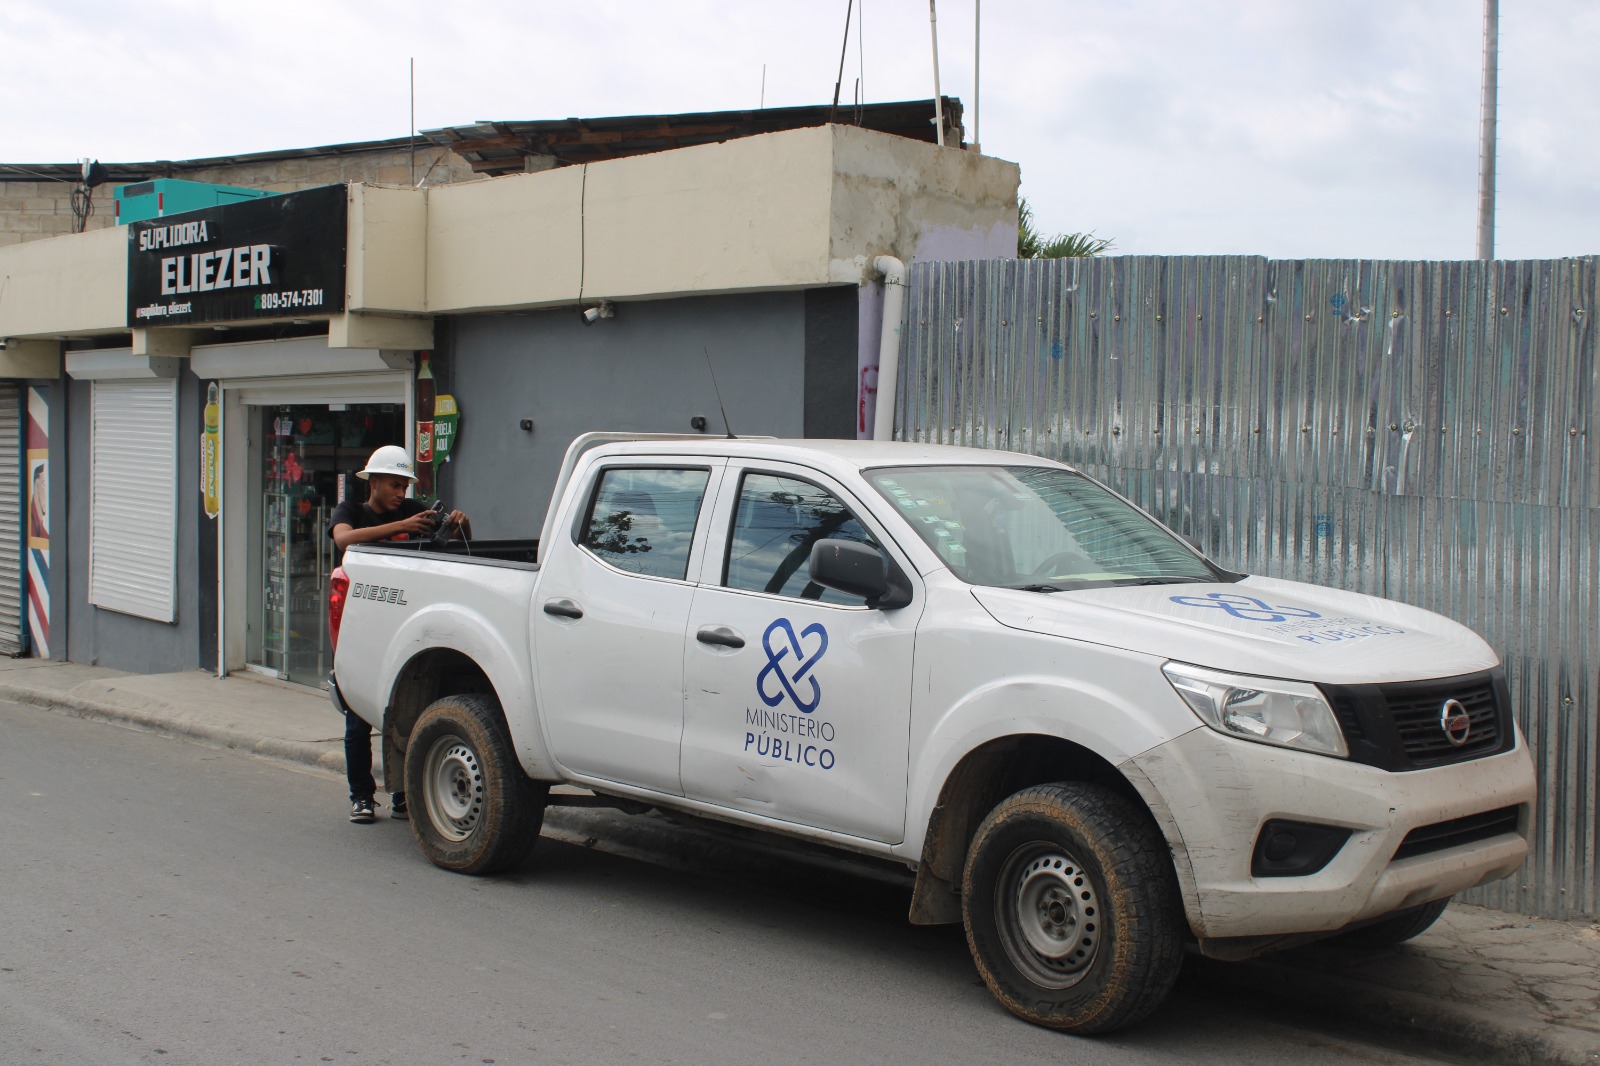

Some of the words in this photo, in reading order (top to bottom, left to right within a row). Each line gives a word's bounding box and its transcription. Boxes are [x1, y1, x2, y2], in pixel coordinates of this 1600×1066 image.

[139, 220, 208, 251] SUPLIDORA
[161, 244, 271, 295] ELIEZER
[261, 288, 323, 309] 809-574-7301
[352, 582, 408, 606] DIESEL
[746, 707, 835, 742] MINISTERIO
[744, 731, 835, 770] PÚBLICO
